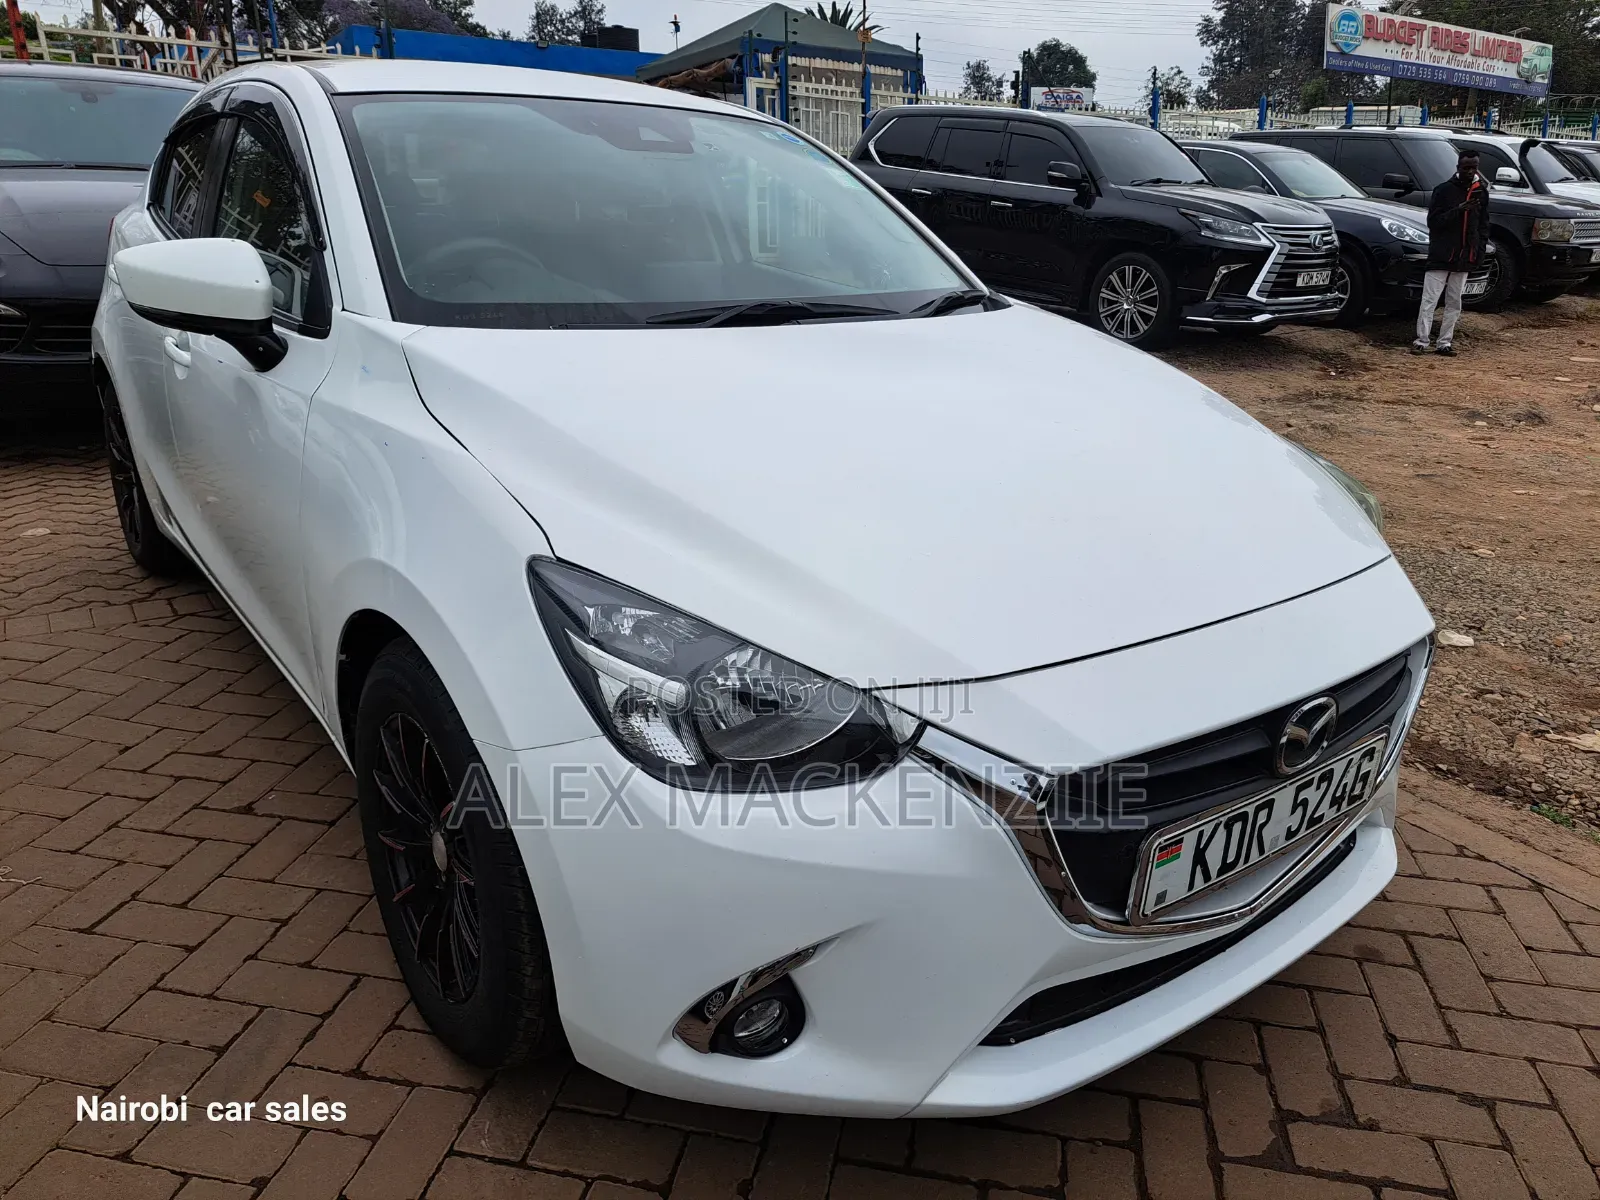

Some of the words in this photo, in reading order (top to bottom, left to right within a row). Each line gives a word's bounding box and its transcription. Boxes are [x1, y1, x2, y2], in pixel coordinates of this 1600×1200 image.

[1338, 20, 1358, 34] BR
[1363, 14, 1427, 49] BUDGET
[1428, 26, 1470, 54] RIDES
[1471, 30, 1523, 63] LIMITED
[1328, 57, 1348, 67] Dealers
[1354, 60, 1365, 69] New
[1369, 62, 1381, 71] Used
[1415, 50, 1426, 62] All
[1428, 51, 1445, 64] Your
[1445, 54, 1481, 70] Affordable
[1398, 64, 1417, 77] 0729
[1418, 67, 1432, 79] 535
[1433, 69, 1447, 80] 564
[1453, 72, 1470, 85] 0759
[1471, 75, 1483, 86] 090
[1485, 76, 1497, 88] 089
[1187, 797, 1276, 893] KDR
[1285, 747, 1376, 841] 524G
